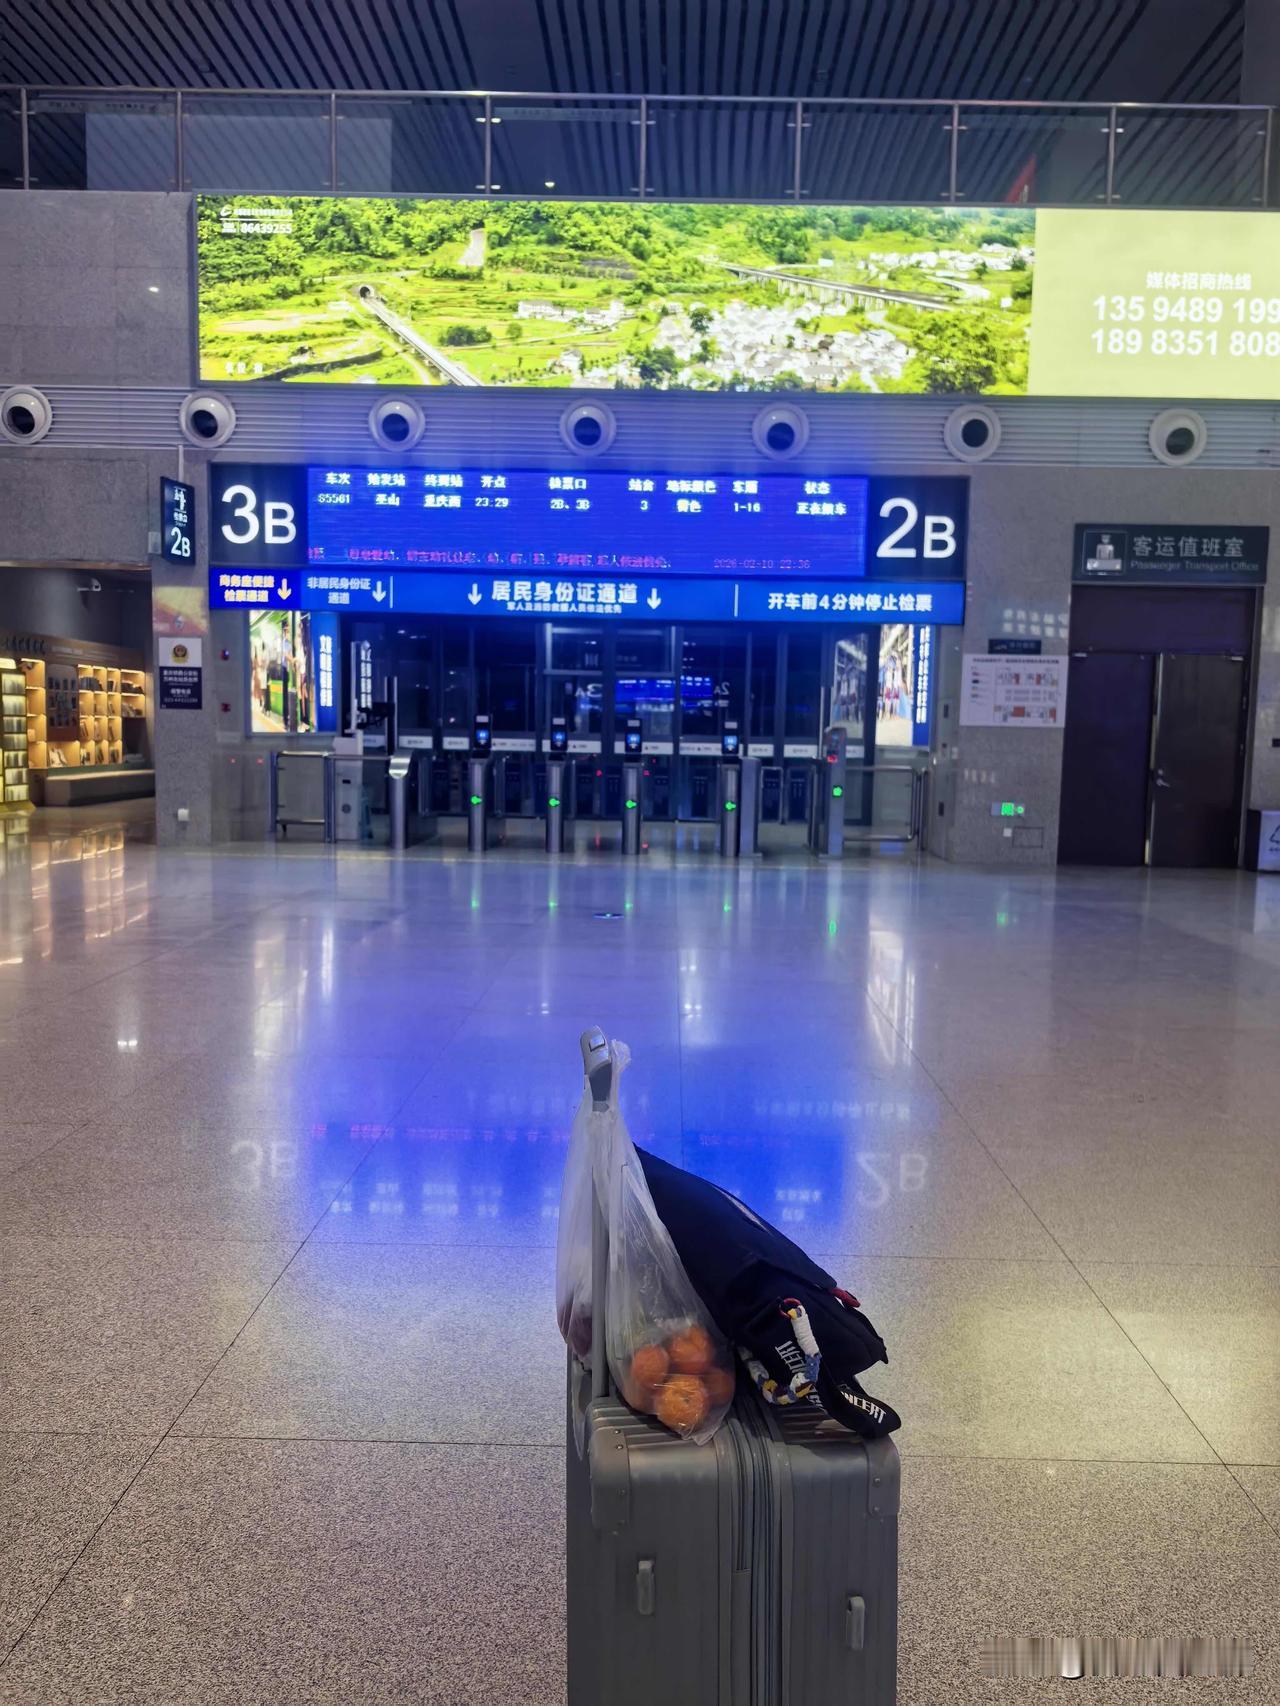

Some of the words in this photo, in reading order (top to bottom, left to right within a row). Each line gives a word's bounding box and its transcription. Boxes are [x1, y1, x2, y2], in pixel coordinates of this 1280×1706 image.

[1146, 271, 1252, 290] 媒体招商热线
[1093, 295, 1145, 322] 135
[1152, 296, 1223, 323] 9489
[1091, 328, 1143, 354] 189
[1151, 329, 1218, 356] 8351
[326, 472, 351, 485] 车次
[367, 473, 406, 487] 始发站
[481, 475, 506, 488] 开点
[549, 477, 587, 490] 检票口
[804, 481, 831, 494] 状态
[221, 484, 297, 545] 3B
[475, 497, 509, 507] 23:29
[640, 500, 649, 511] 3
[734, 502, 761, 512] 1-16
[876, 497, 957, 559] 2B
[171, 526, 191, 557] 2B
[1132, 535, 1244, 557] 客运值班室
[307, 576, 371, 590] 非居民身份证
[491, 580, 638, 604] 居民身份证通道
[224, 589, 269, 603] 检票通道
[328, 592, 350, 604] 通道
[768, 592, 933, 612] 开车前4分钟停止检票
[840, 1390, 887, 1424] NCERT
